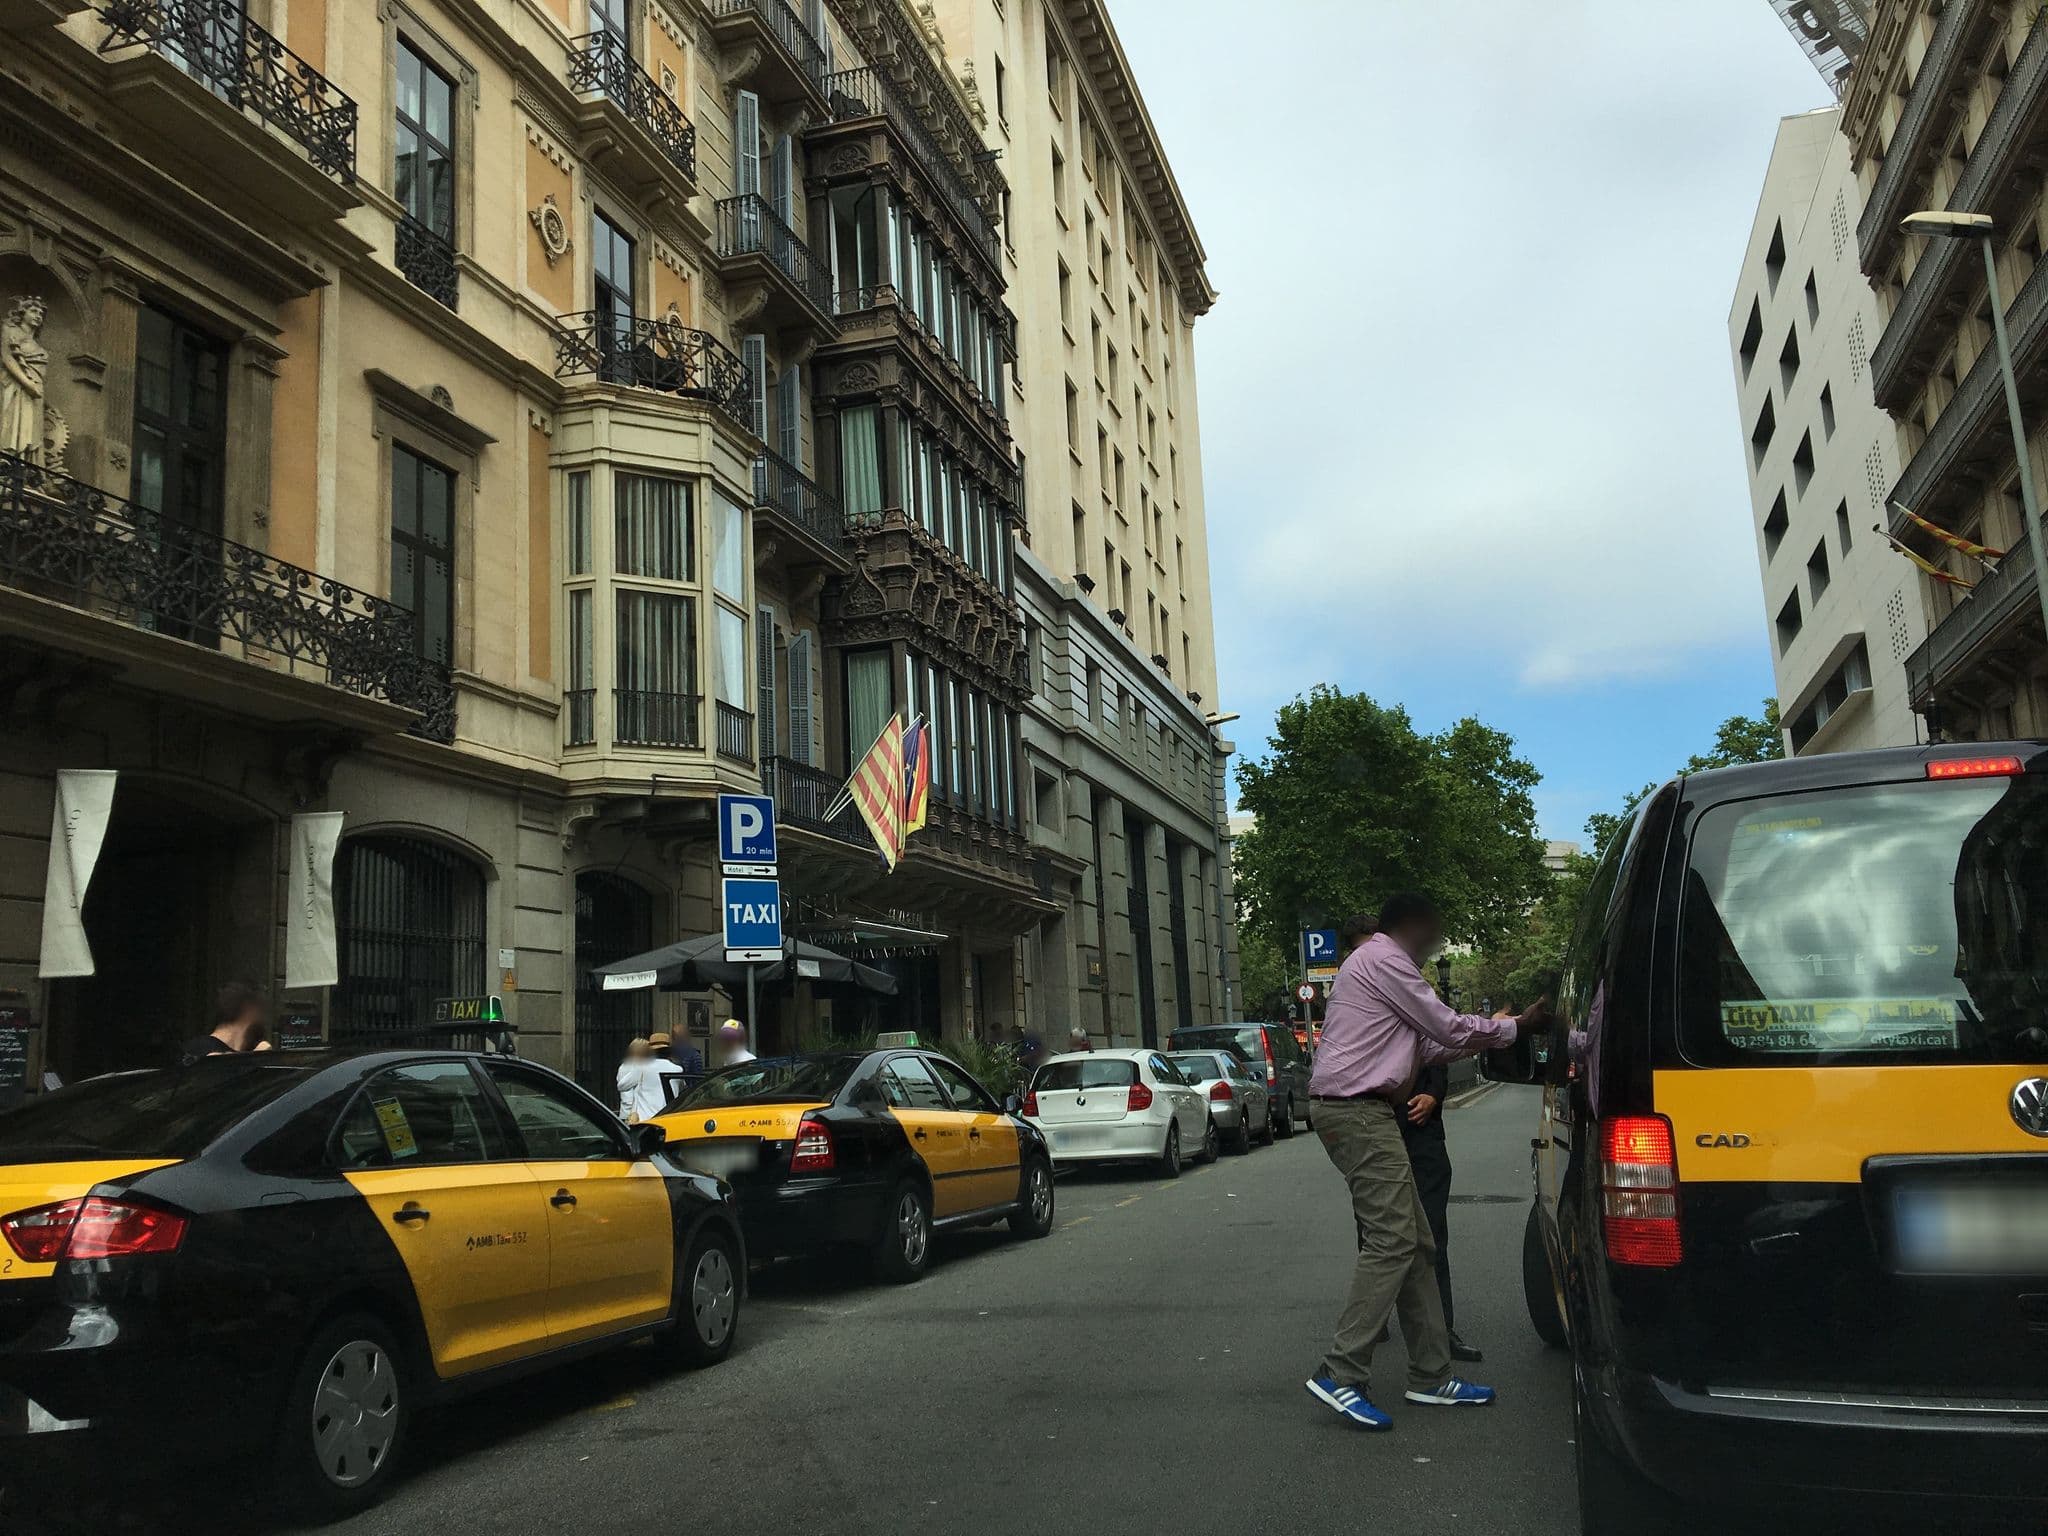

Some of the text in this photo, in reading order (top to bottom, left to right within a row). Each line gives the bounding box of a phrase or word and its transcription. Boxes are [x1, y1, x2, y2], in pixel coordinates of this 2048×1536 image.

[730, 802, 764, 854] P
[745, 846, 757, 855] 20
[729, 903, 777, 924] TAXI
[1308, 933, 1324, 957] P
[451, 1000, 480, 1019] TAXI
[1731, 1035, 1747, 1048] 93
[1778, 1034, 1796, 1047] 84
[1870, 1033, 1948, 1047] citytaxi.cat
[3, 1258, 13, 1273] 2
